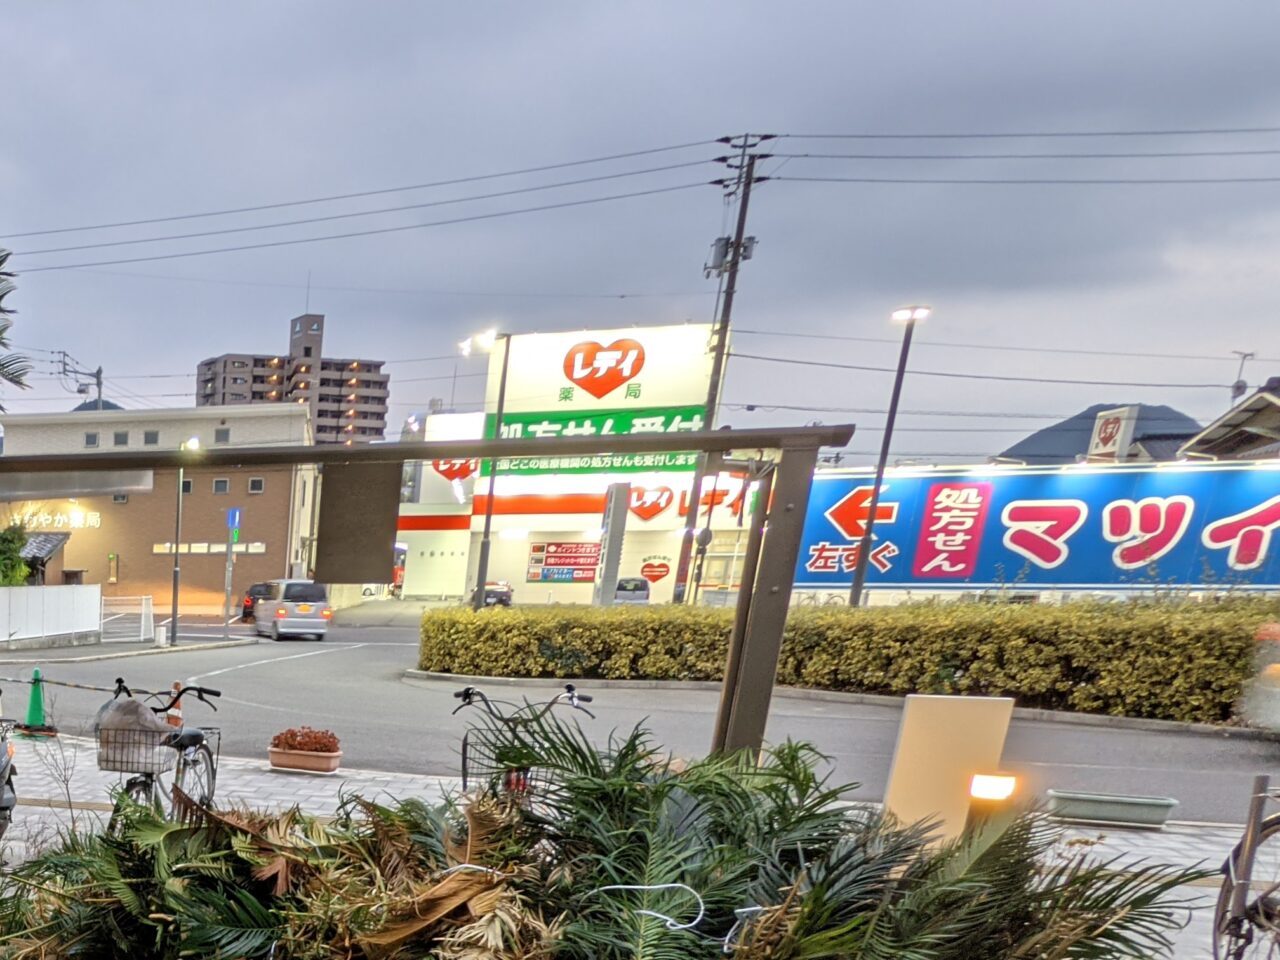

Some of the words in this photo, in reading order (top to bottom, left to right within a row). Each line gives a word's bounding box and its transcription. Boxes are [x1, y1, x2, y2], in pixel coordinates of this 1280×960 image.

[625, 382, 641, 399] 局
[920, 487, 983, 573] 処方せん
